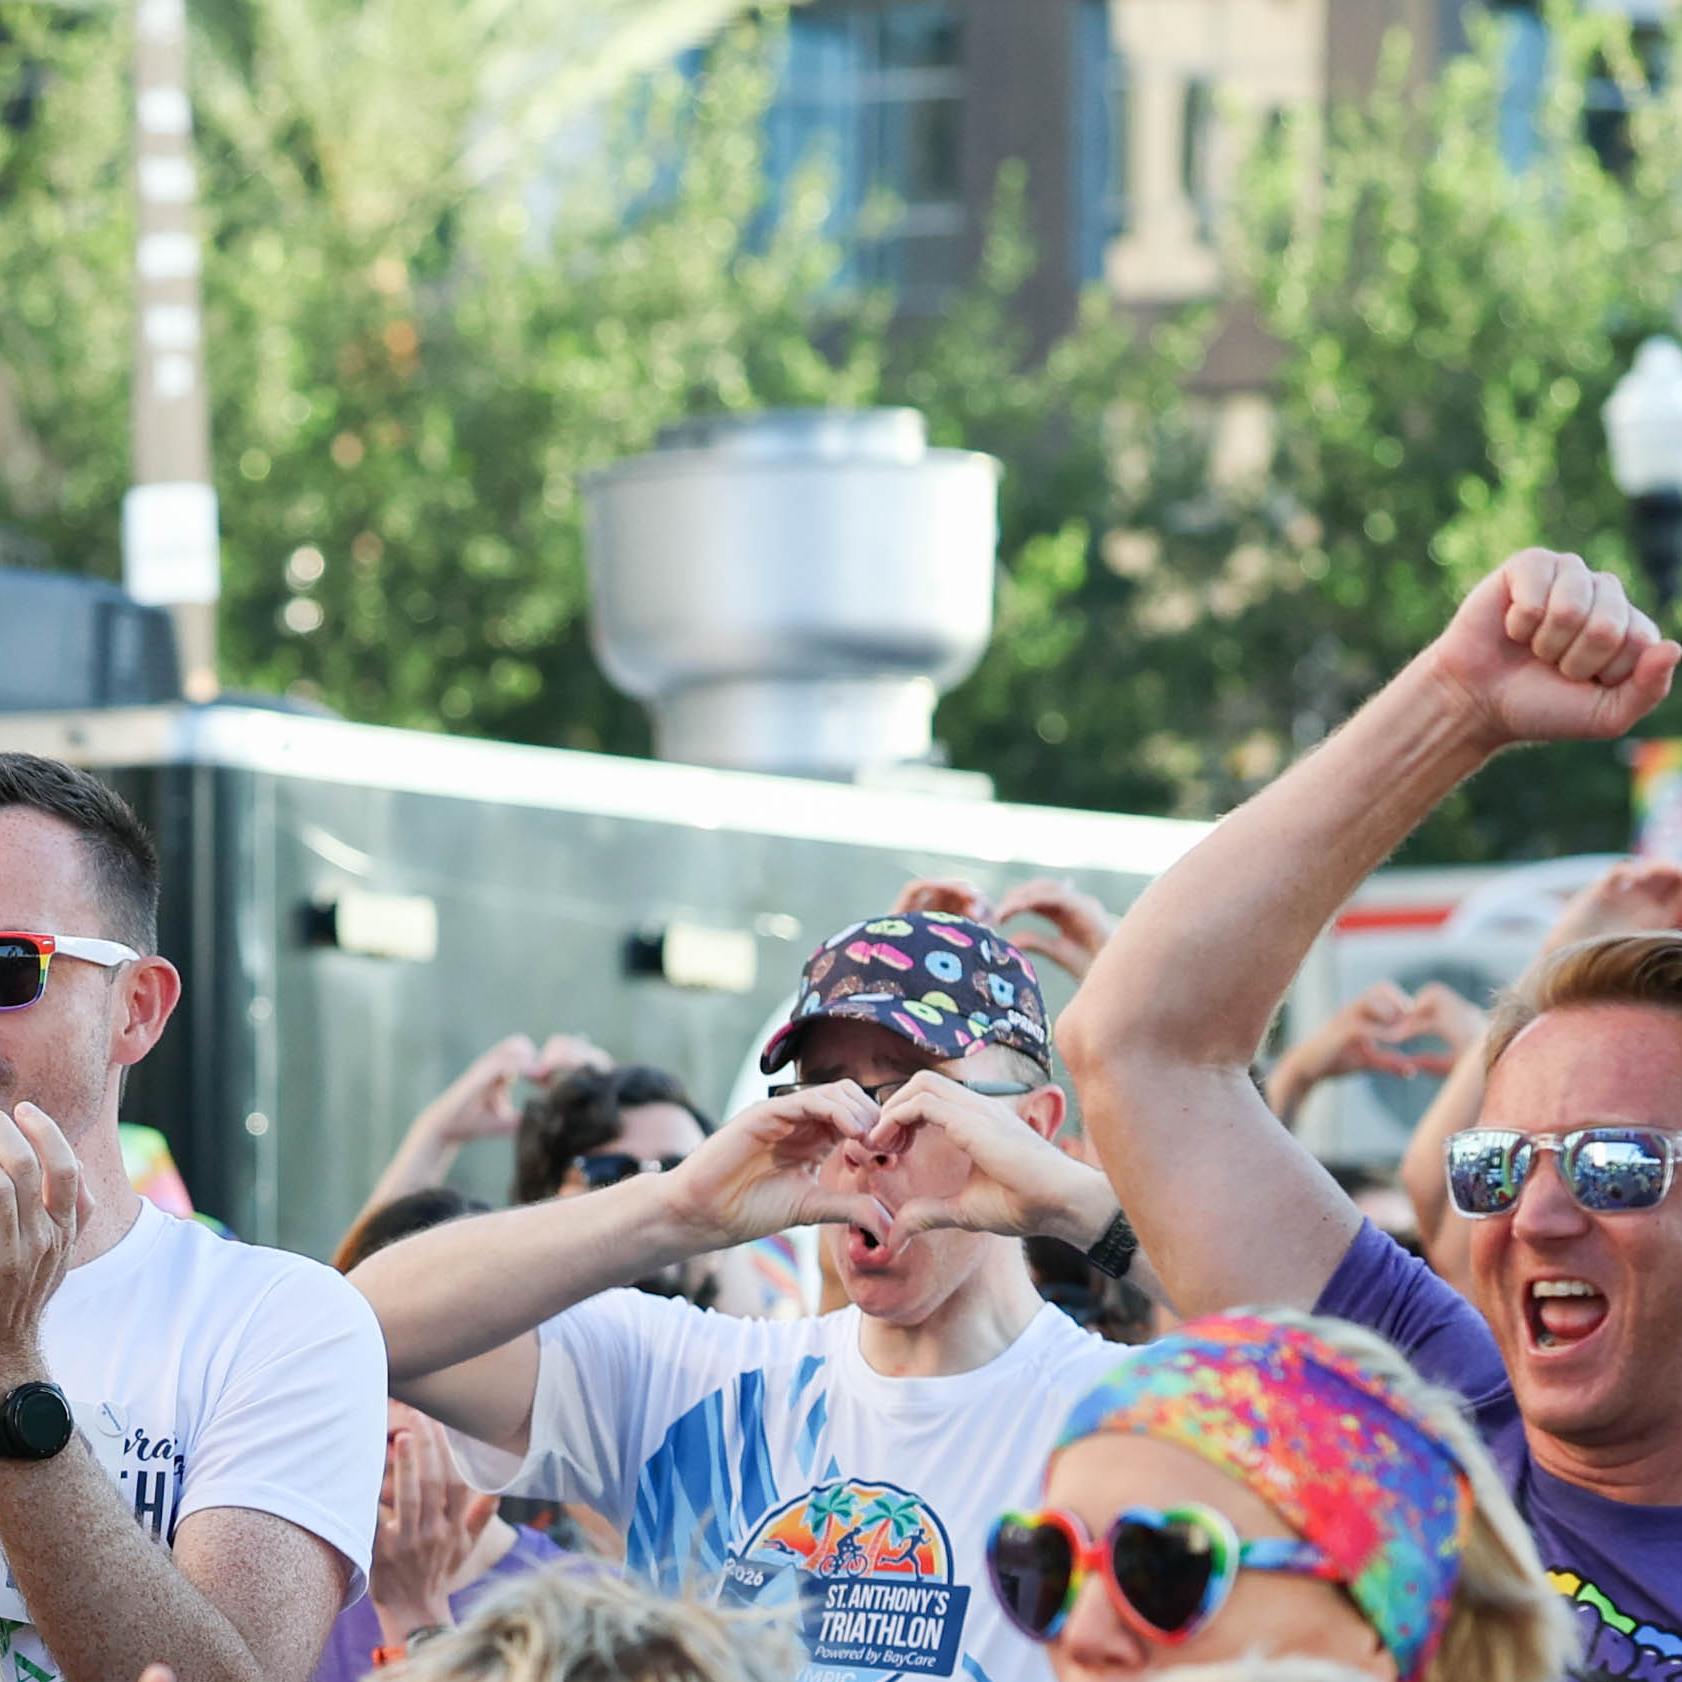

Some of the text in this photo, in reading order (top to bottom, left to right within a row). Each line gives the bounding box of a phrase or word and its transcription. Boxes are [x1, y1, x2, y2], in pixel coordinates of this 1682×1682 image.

[724, 1558, 764, 1587] 2026
[819, 1611, 945, 1650] TRIATHLON
[815, 1645, 936, 1667] Powered by BayCare
